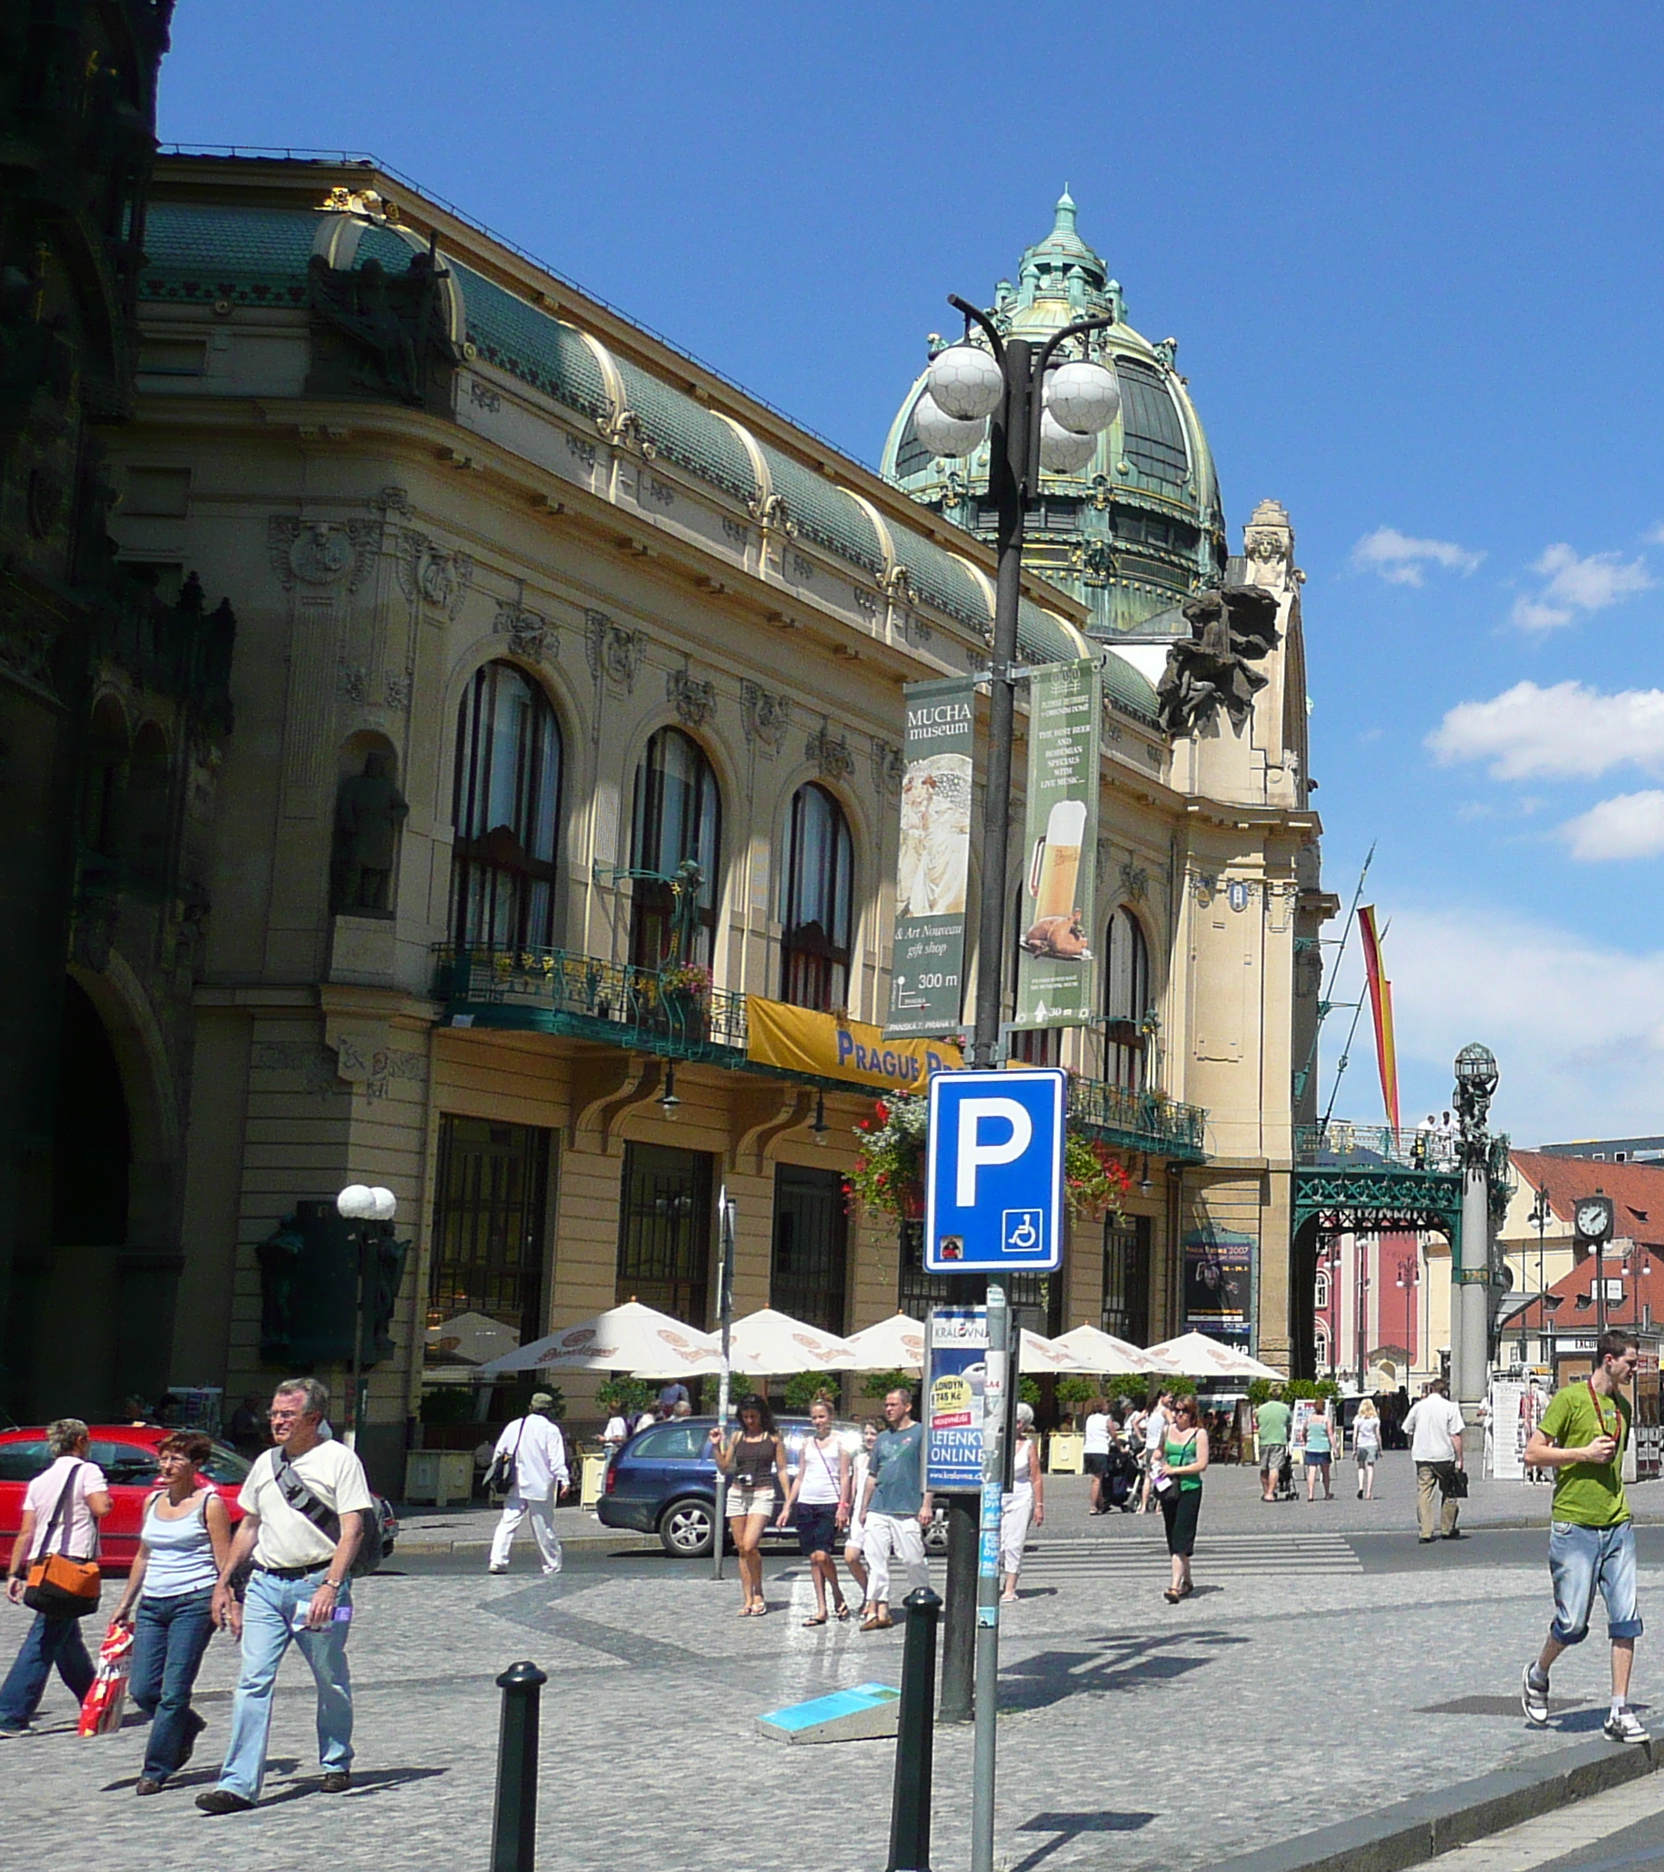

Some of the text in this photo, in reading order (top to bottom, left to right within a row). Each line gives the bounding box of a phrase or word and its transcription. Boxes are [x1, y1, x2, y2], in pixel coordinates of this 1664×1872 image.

[908, 703, 972, 727] MUCHA
[910, 722, 968, 740] museum
[895, 925, 962, 940] & Art Nouveau
[906, 941, 947, 959] gift shop
[918, 973, 957, 988] 300 m
[1048, 1007, 1062, 1017] 30
[924, 1020, 950, 1030] PRAHA
[837, 1029, 920, 1082] PRAGUE
[956, 1097, 1032, 1208] P
[935, 1324, 990, 1338] KRÁLOVN
[935, 1377, 963, 1391] LONDÝN
